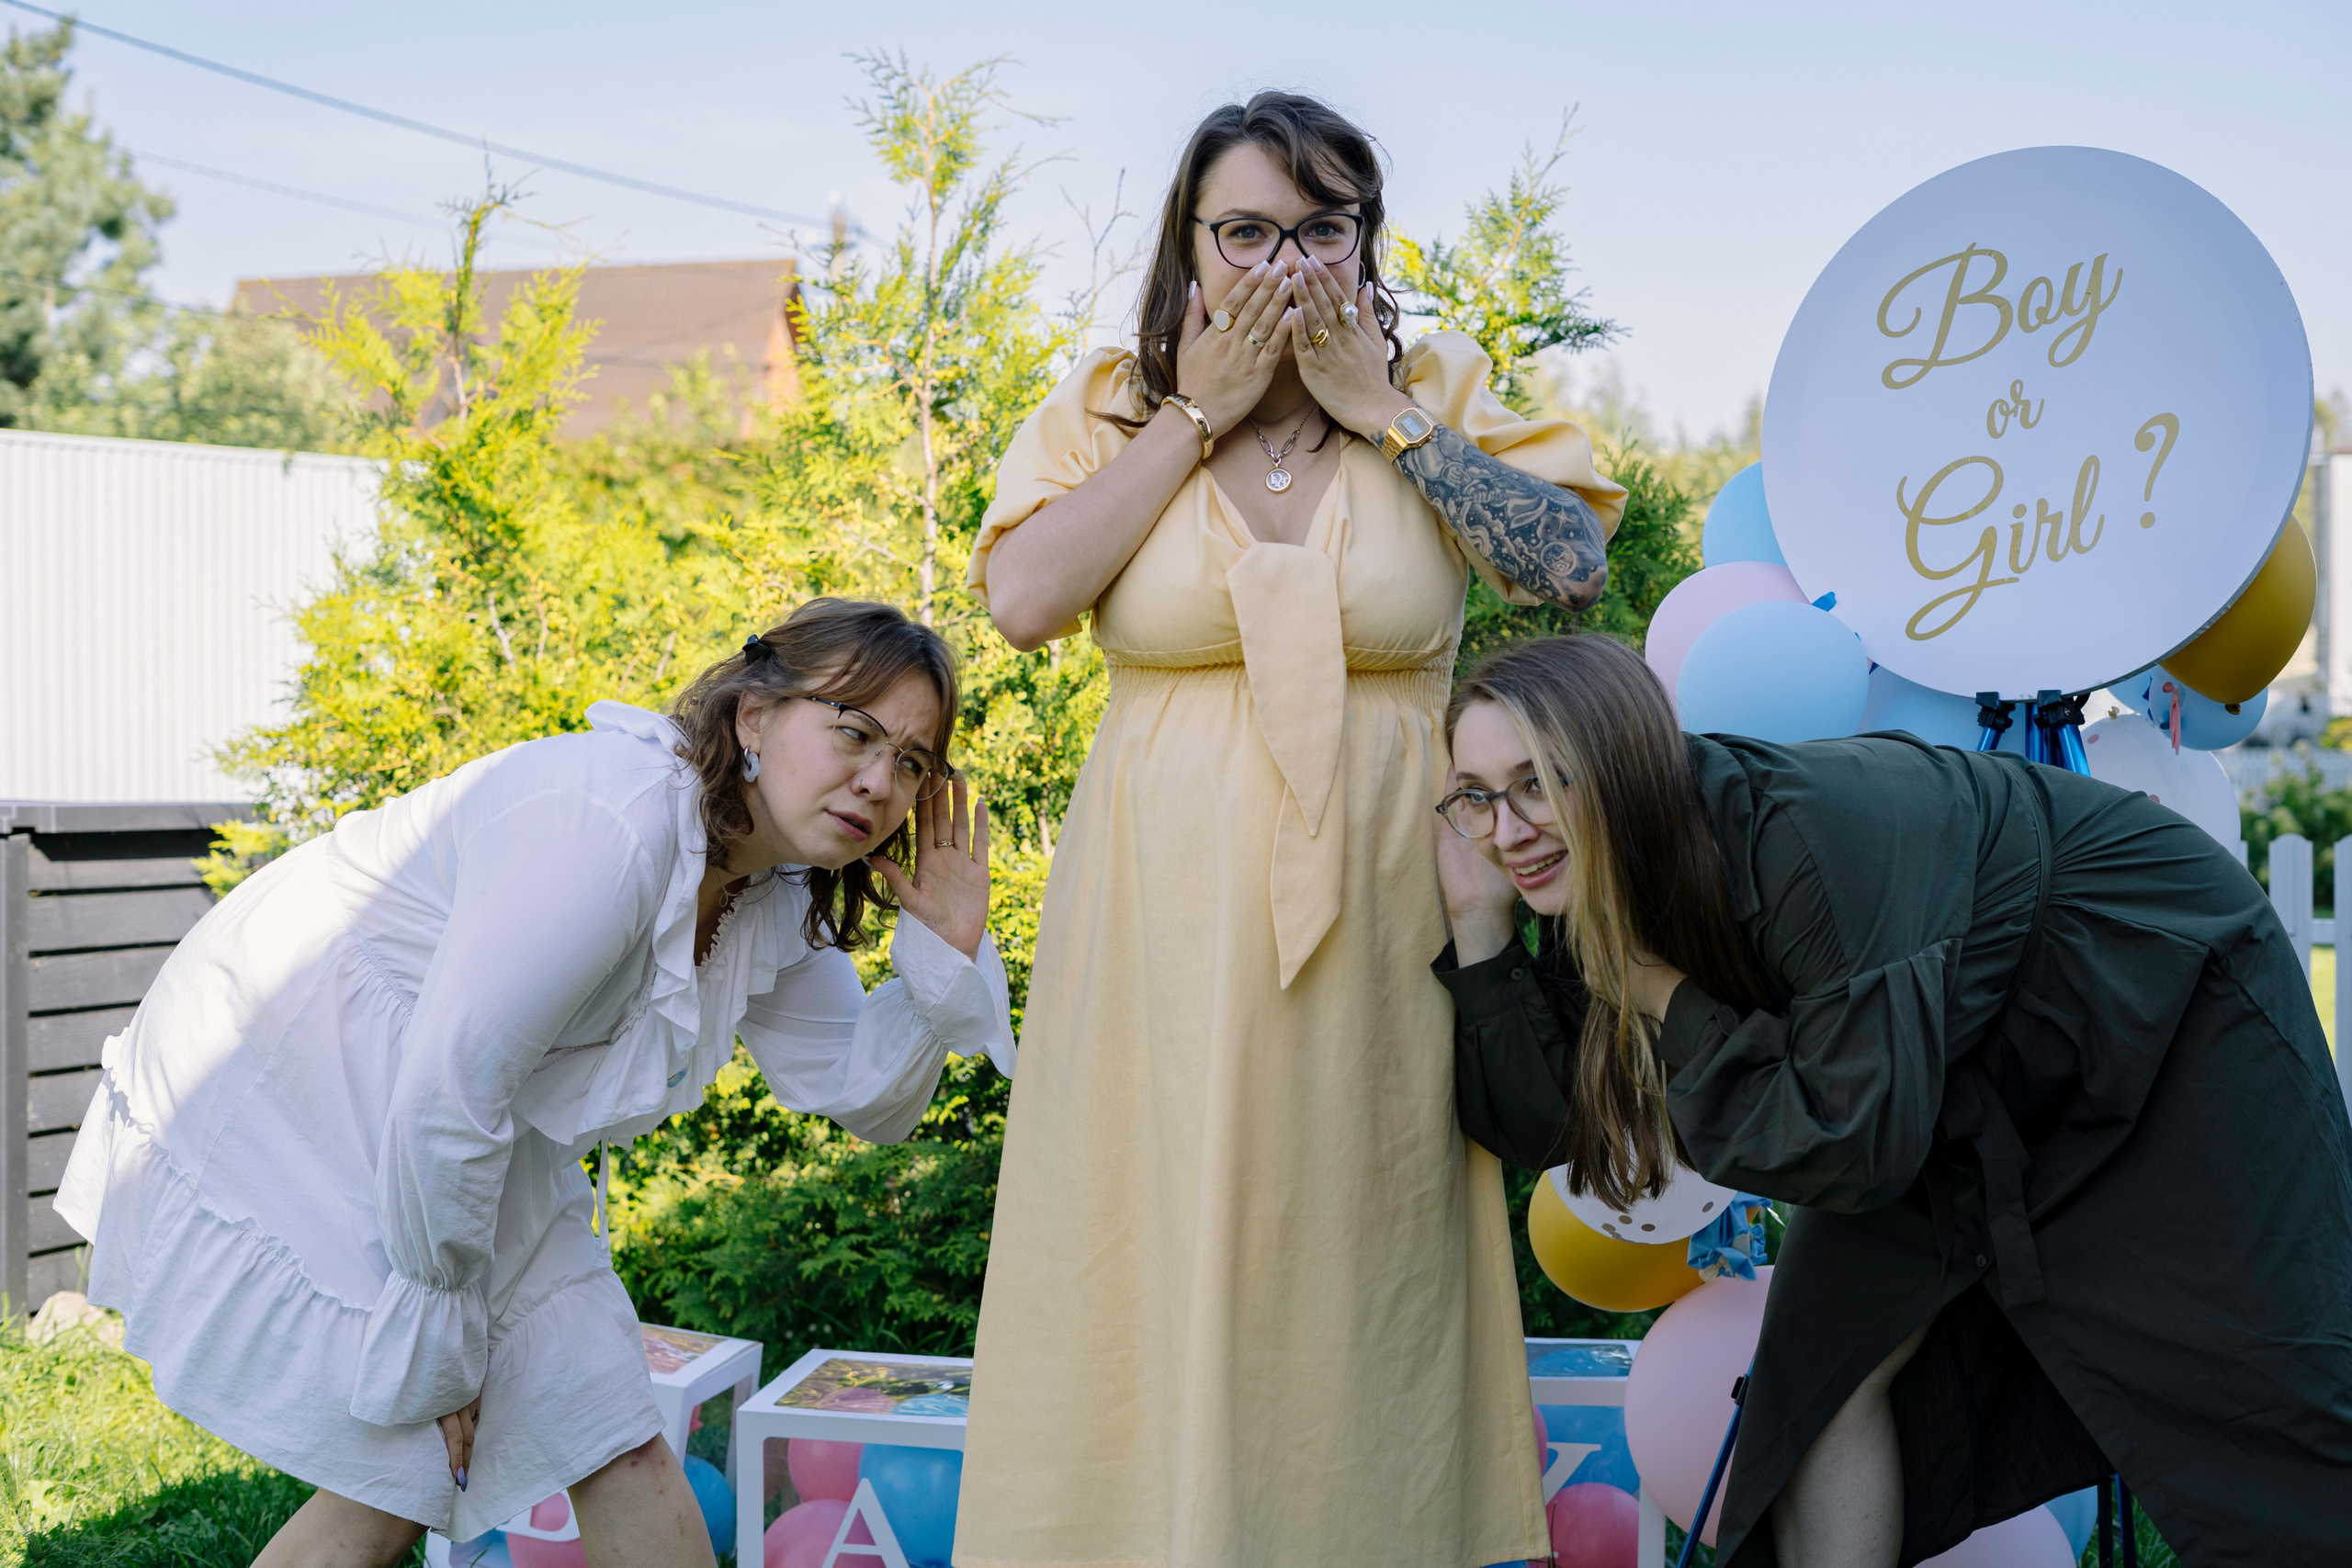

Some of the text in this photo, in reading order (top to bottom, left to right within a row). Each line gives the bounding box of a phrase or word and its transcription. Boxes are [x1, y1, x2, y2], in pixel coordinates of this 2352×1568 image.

[1876, 243, 2123, 389] Boy
[1986, 379, 2044, 439] or
[1896, 455, 2105, 641] Girl
[820, 1477, 910, 1568] A
